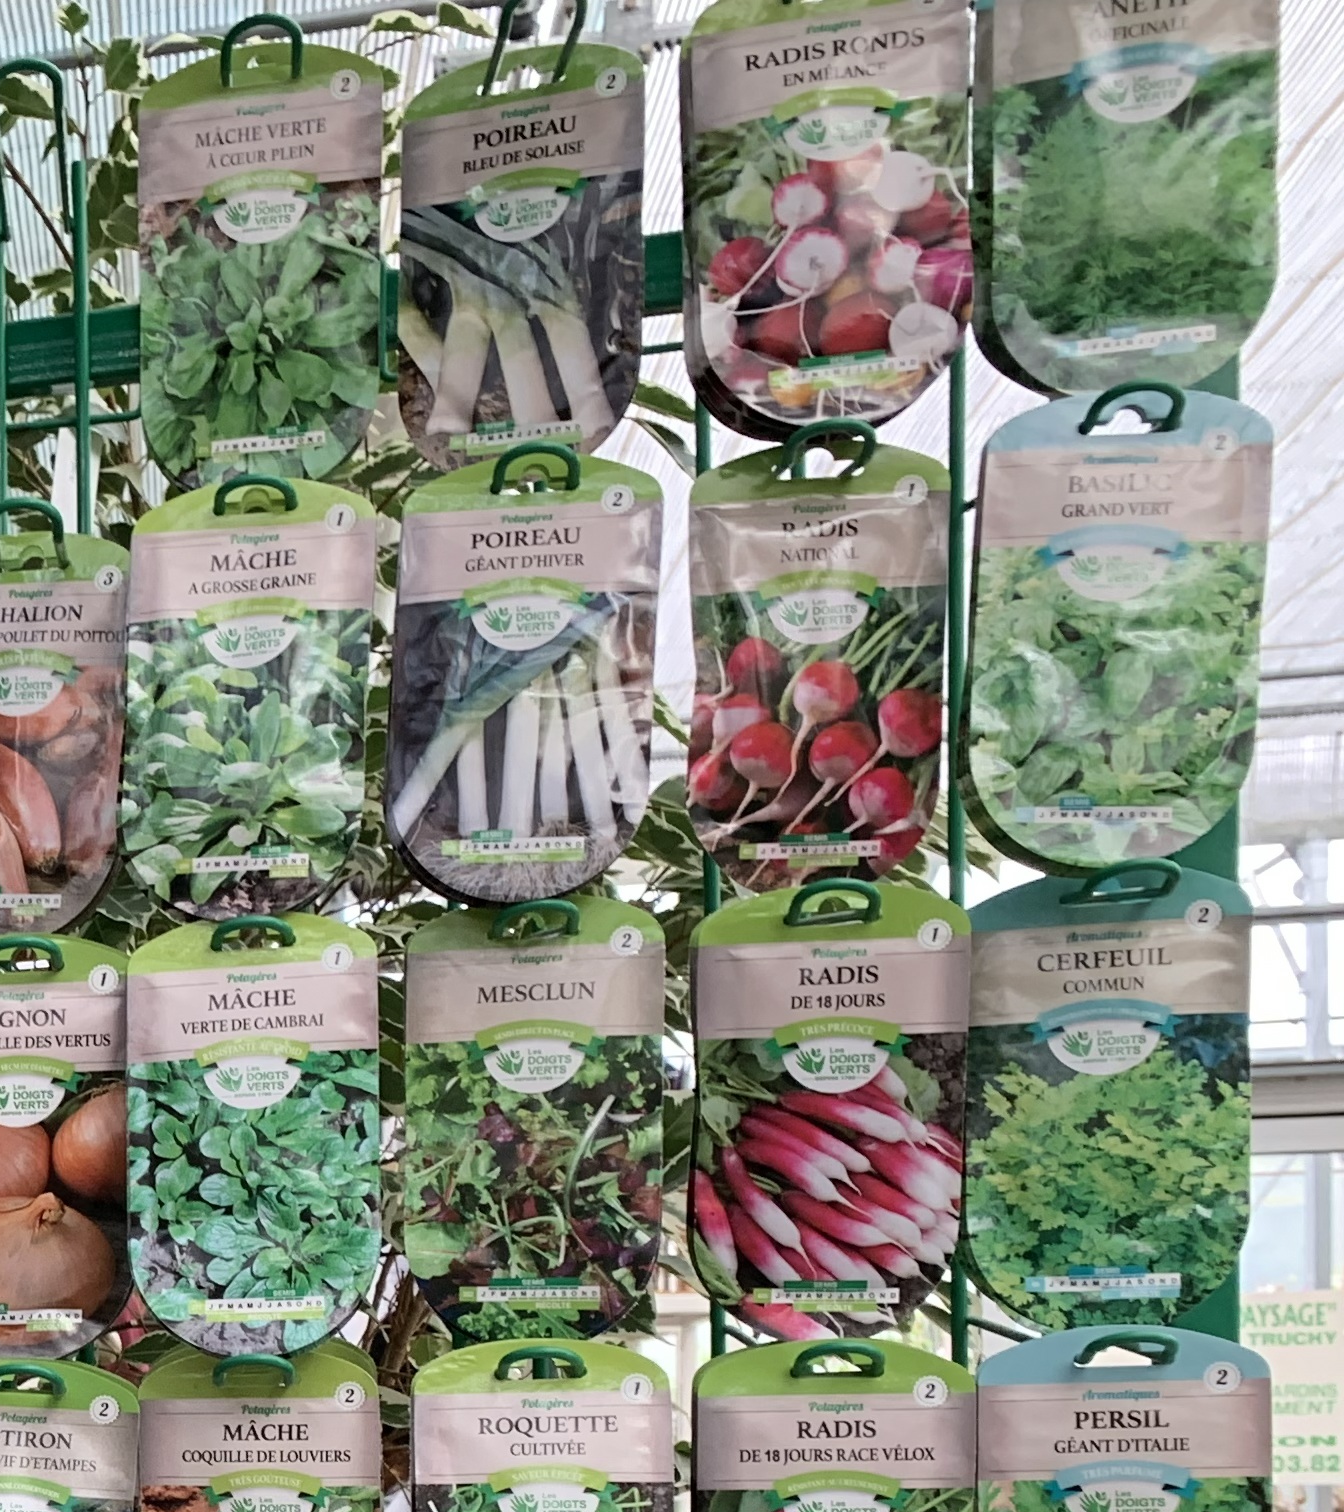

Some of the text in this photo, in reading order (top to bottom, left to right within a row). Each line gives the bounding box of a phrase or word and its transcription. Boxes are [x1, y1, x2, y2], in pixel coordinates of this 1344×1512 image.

[746, 31, 924, 71] RADIS RONDS
[196, 118, 325, 148] MÂCHE VERTE
[474, 116, 575, 154] POIREAU
[472, 527, 580, 549] POIREAU
[781, 519, 858, 537] RADIS
[211, 549, 296, 571] MÂCHE
[1038, 948, 1172, 972] CERFEUIL
[800, 965, 878, 985] RADIS
[1063, 977, 1143, 994] COMMUN
[209, 988, 295, 1010] MÂCHE
[478, 983, 593, 1004] MESCLUN
[1249, 1331, 1336, 1346] TRUCHY
[345, 1389, 354, 1403] 2
[479, 1416, 618, 1438] ROQUETTE
[798, 1420, 876, 1438] RADIS
[1074, 1410, 1169, 1429] PERSIL
[223, 1420, 308, 1441] MÂCHE
[510, 1443, 585, 1456] CULTIVÉE
